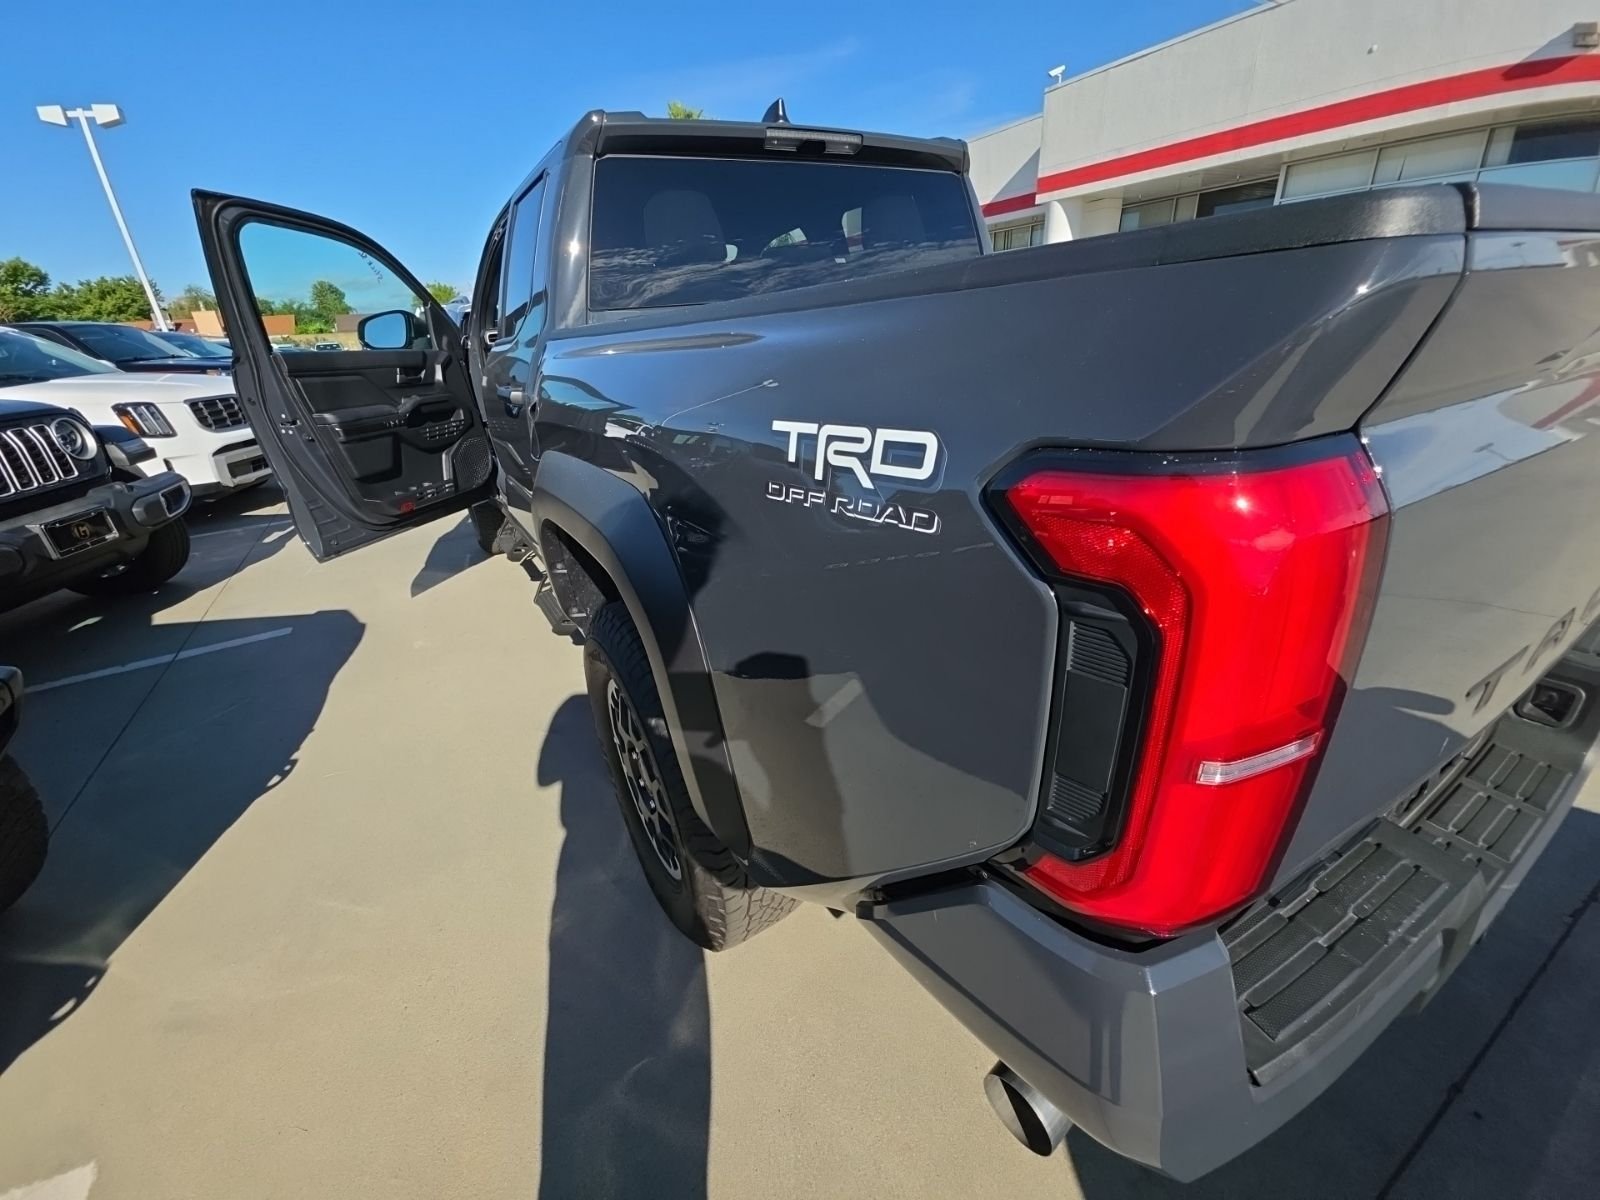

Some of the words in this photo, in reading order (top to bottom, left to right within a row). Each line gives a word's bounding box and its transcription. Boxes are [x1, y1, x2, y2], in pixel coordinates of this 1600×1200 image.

[771, 420, 938, 489] TRD
[765, 480, 826, 507] OFF
[830, 497, 941, 534] ROAD
